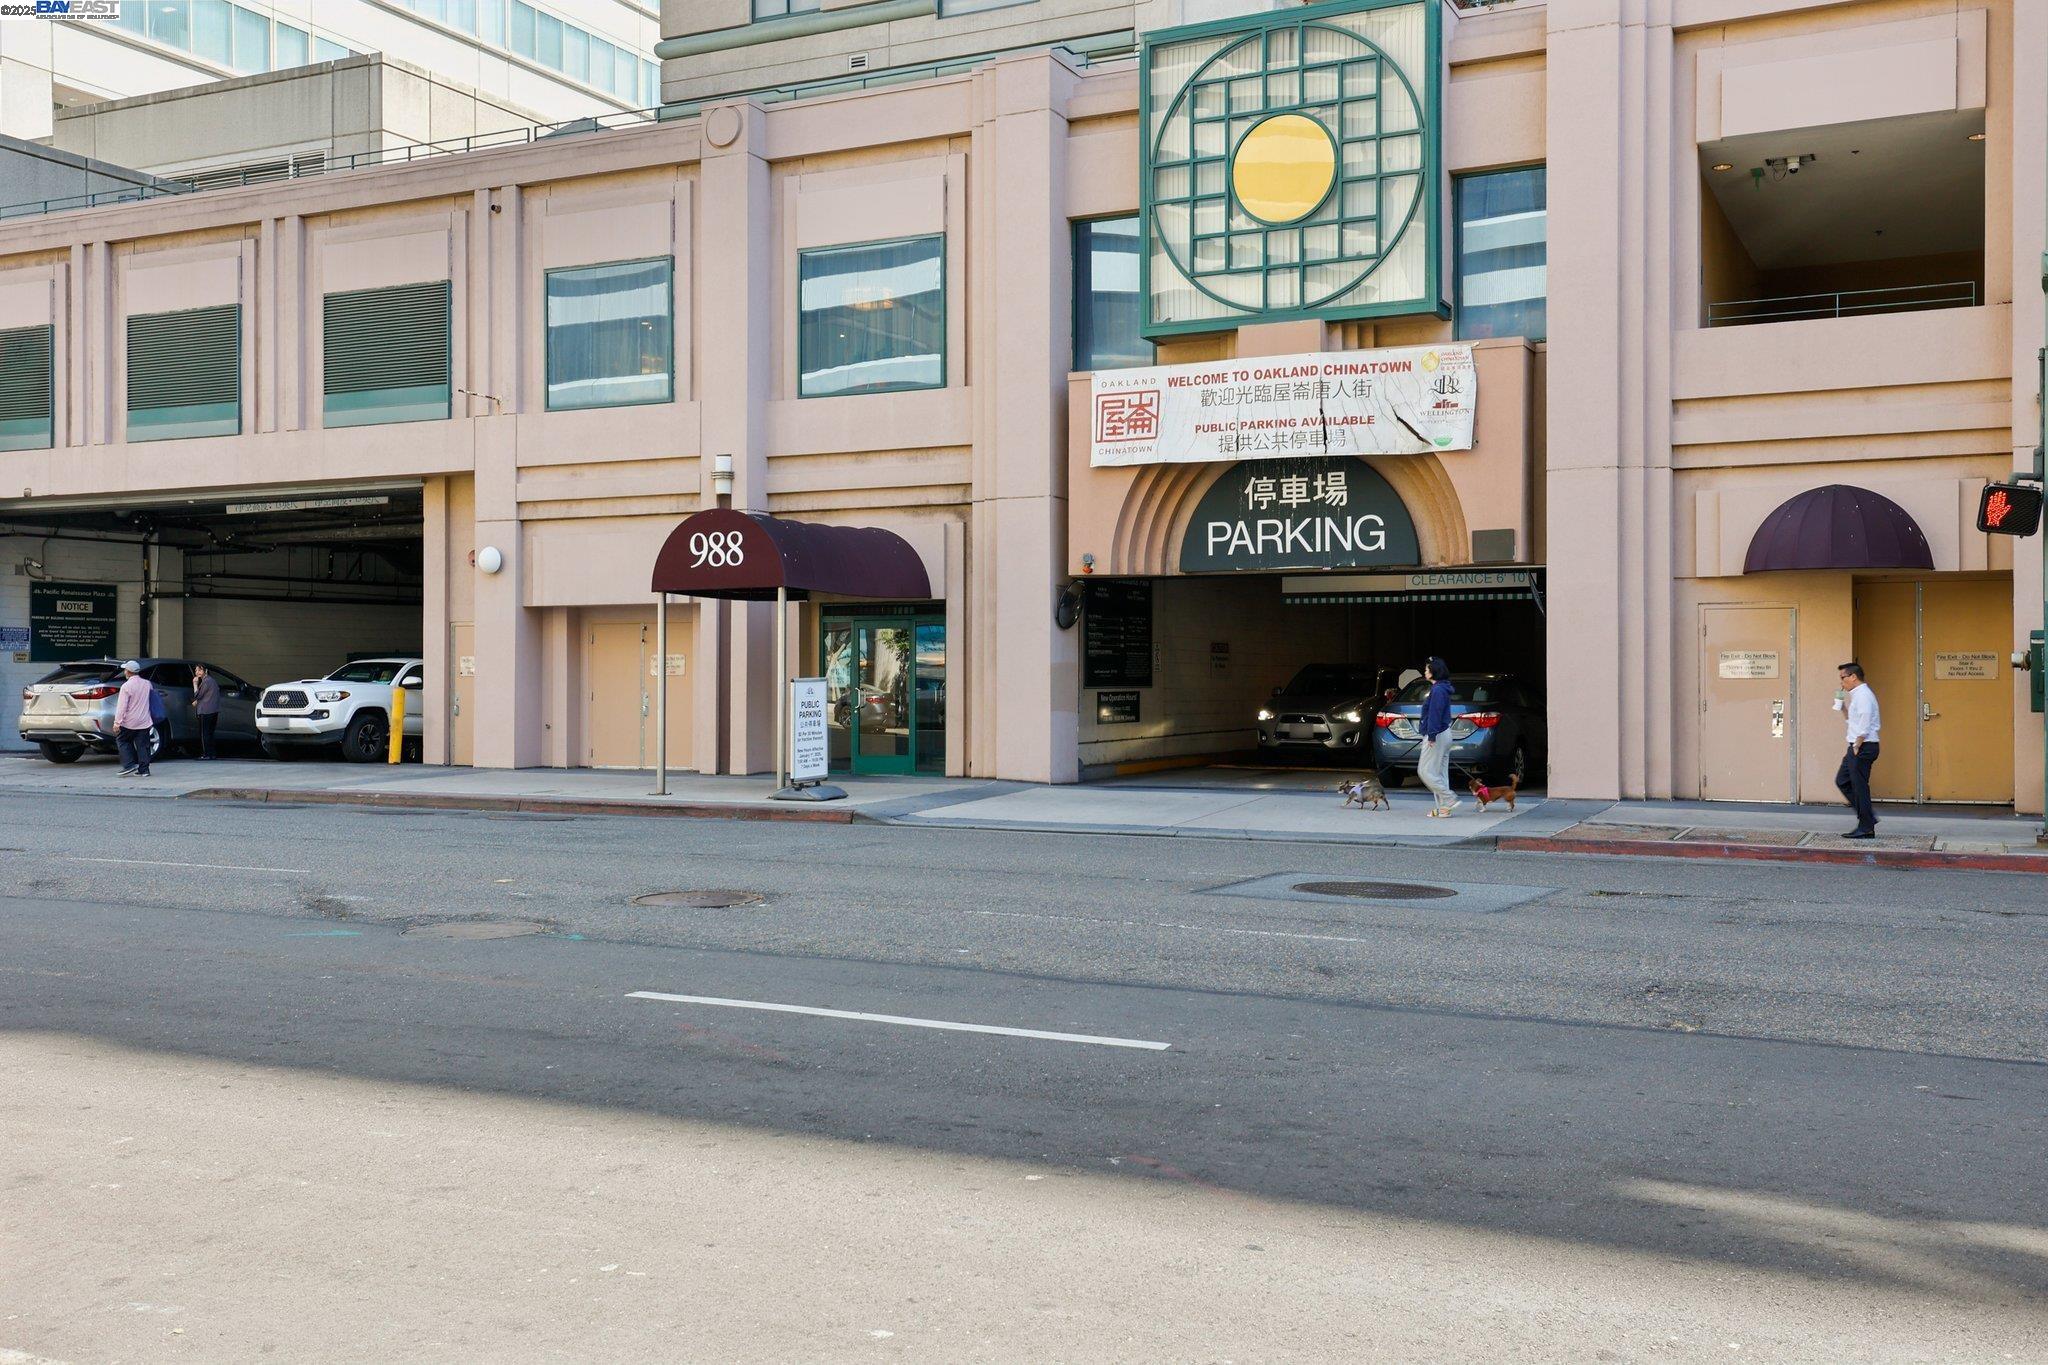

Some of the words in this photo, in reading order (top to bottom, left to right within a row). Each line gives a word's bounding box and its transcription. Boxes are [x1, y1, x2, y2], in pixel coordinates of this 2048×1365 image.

[1101, 378, 1156, 388] OAKLAND
[1168, 373, 1228, 388] WELCOME
[1232, 371, 1249, 382] TO
[1254, 365, 1318, 380] OAKLAND
[1324, 360, 1412, 376] CHINATOWN
[1195, 422, 1236, 434] PUBLIC
[1240, 418, 1297, 430] PARKING
[1301, 414, 1376, 426] AVAILABLE
[1218, 428, 1347, 453] 提供公共停車場
[1098, 446, 1152, 456] CHINATOWN
[1244, 472, 1348, 510] 停車場
[1208, 514, 1386, 556] PARKING
[689, 530, 744, 568] 988
[1412, 573, 1492, 586] CLEARANCE
[60, 603, 88, 611] NOTICE
[799, 710, 821, 718] PARKING
